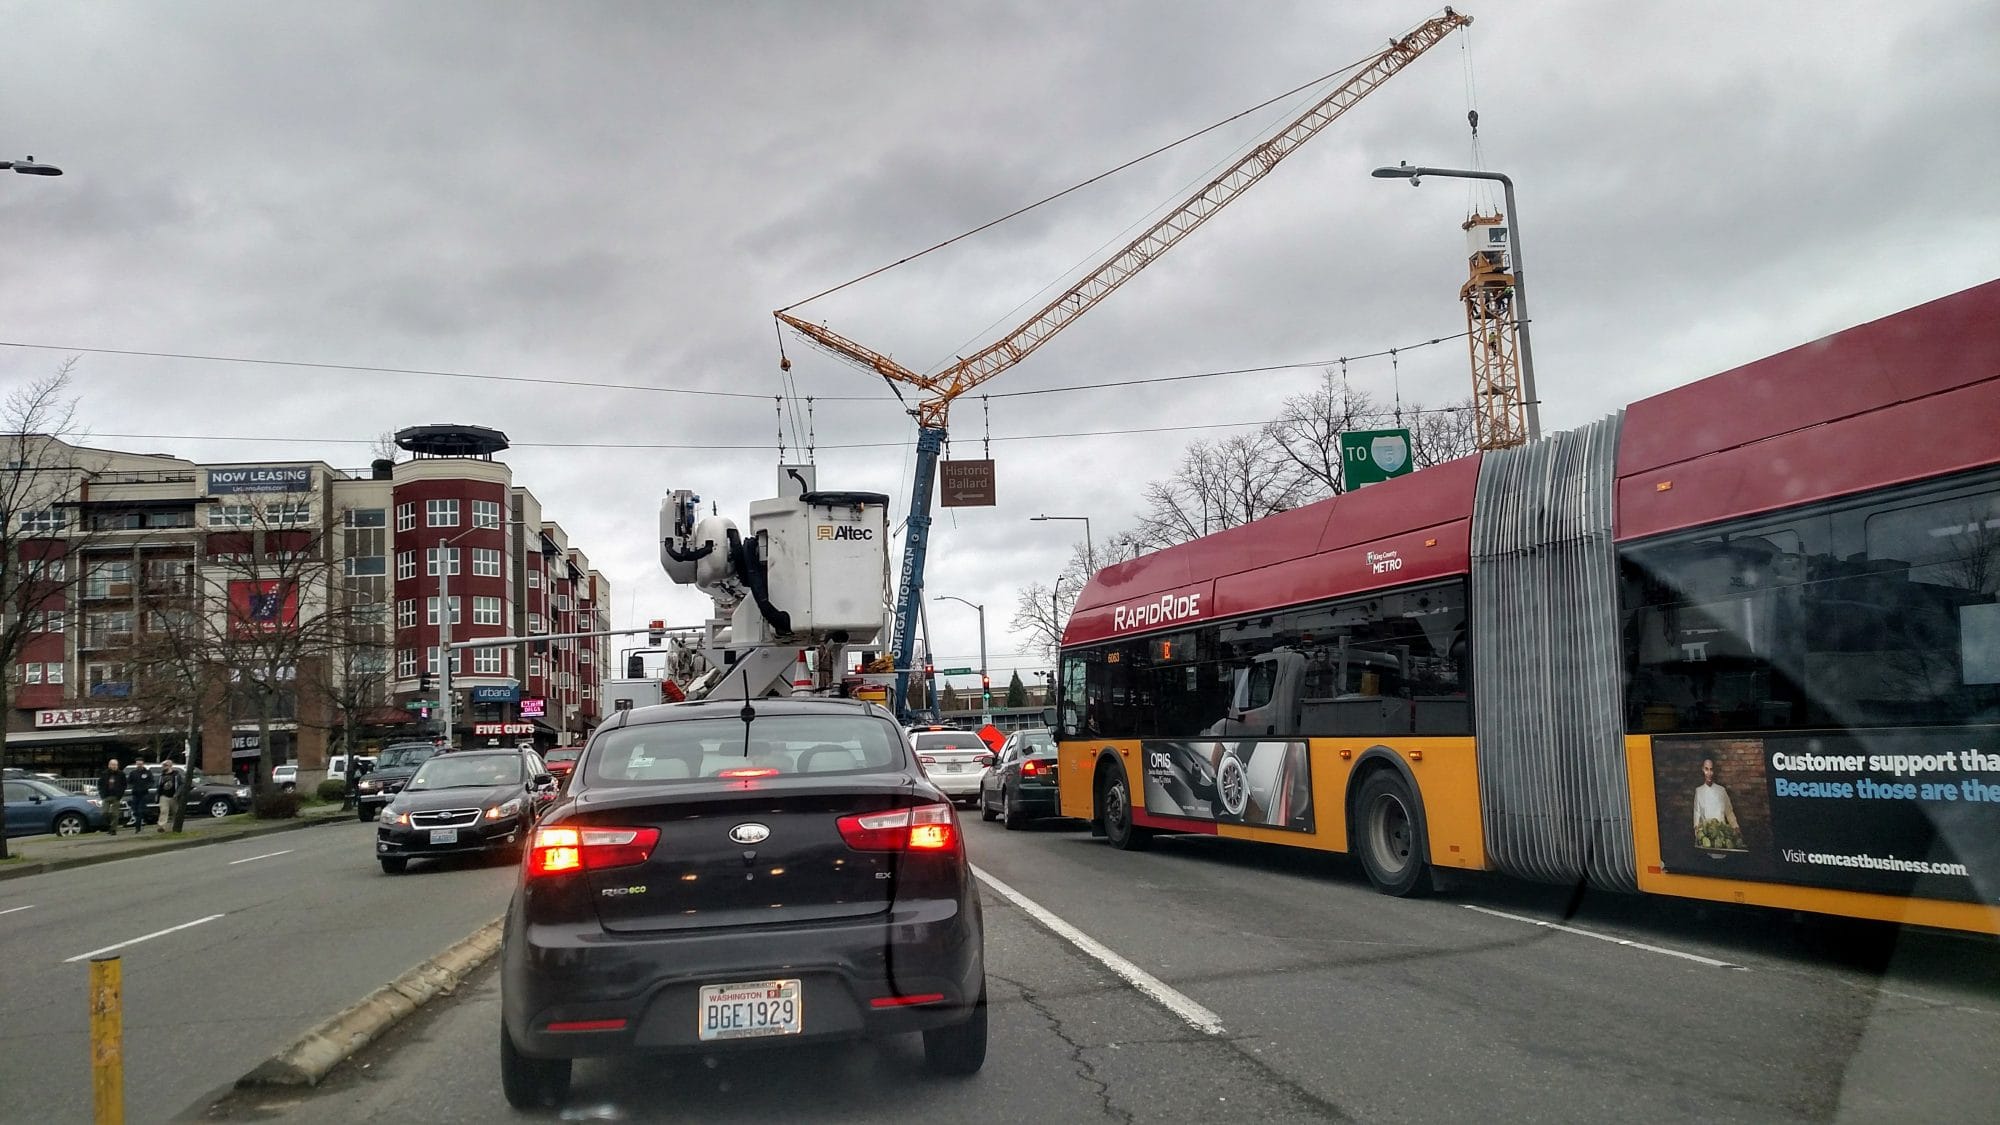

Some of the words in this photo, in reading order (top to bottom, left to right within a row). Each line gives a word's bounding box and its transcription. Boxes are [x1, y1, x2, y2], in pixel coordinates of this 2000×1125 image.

[1346, 446, 1367, 461] TO
[212, 472, 246, 482] NOW
[250, 470, 306, 481] LEASING
[945, 465, 989, 476] Historic
[948, 477, 988, 488] Ballard
[834, 525, 873, 540] Altec
[1372, 558, 1402, 574] METRO
[898, 547, 915, 606] MORGAN
[892, 611, 906, 659] OMEGA
[478, 688, 511, 697] urbana
[475, 724, 502, 734] FIVE
[503, 724, 535, 734] GUYS
[232, 737, 246, 748] IVE
[246, 736, 260, 747] GU
[1150, 752, 1171, 768] ORIS
[1772, 752, 1865, 772] Customer
[1868, 752, 1957, 776] support
[1774, 778, 1854, 798] Because
[1856, 778, 1916, 800] those
[1920, 783, 1958, 801] are
[1782, 849, 1808, 864] Visit
[709, 992, 762, 1002] WASHINGTON
[708, 1000, 794, 1030] BGE1929
